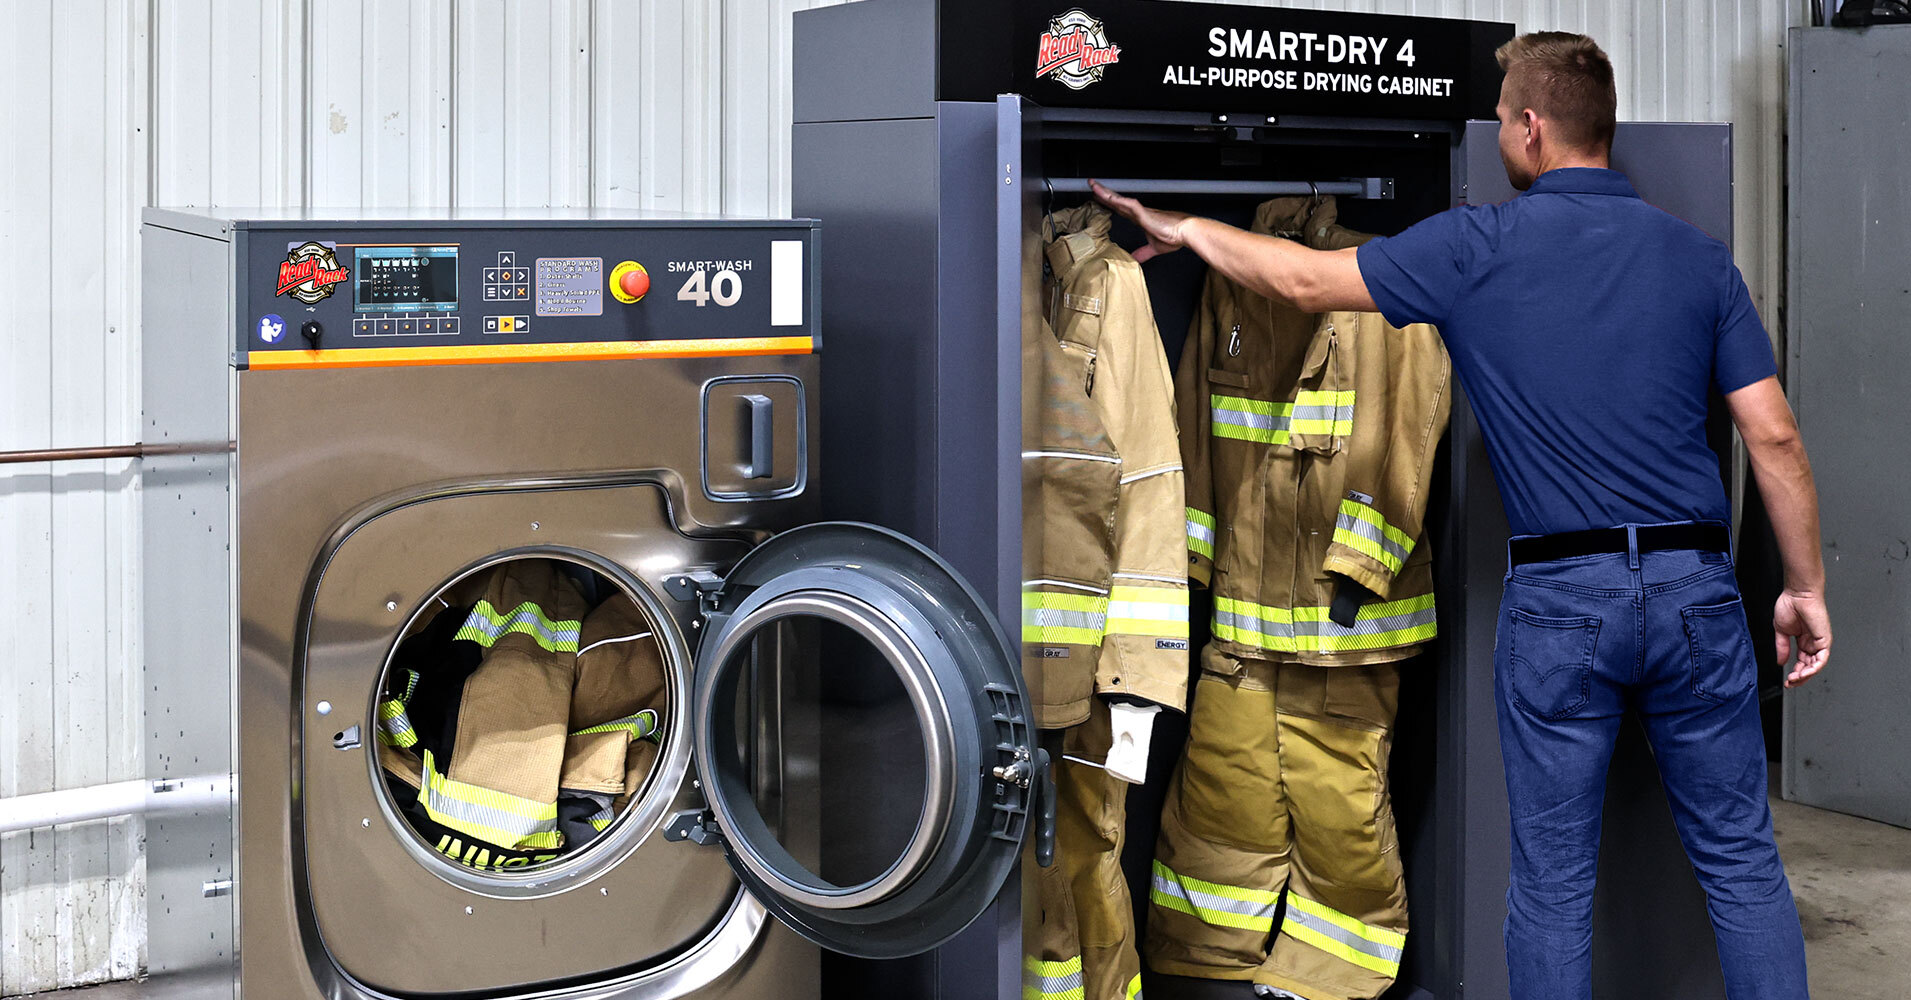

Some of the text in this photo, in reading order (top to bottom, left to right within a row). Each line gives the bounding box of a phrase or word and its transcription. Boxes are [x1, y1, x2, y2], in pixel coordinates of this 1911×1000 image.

[1037, 27, 1087, 72] Ready
[1080, 44, 1122, 71] Rack
[1207, 27, 1416, 67] SMART-DRY 4
[1163, 65, 1454, 97] ALL-PURPOSE DRYING CABINET
[278, 255, 320, 290] Ready
[313, 267, 350, 289] Rack
[668, 260, 752, 272] SMART-WASH
[677, 269, 743, 307] 40
[1157, 640, 1186, 649] ENERGY
